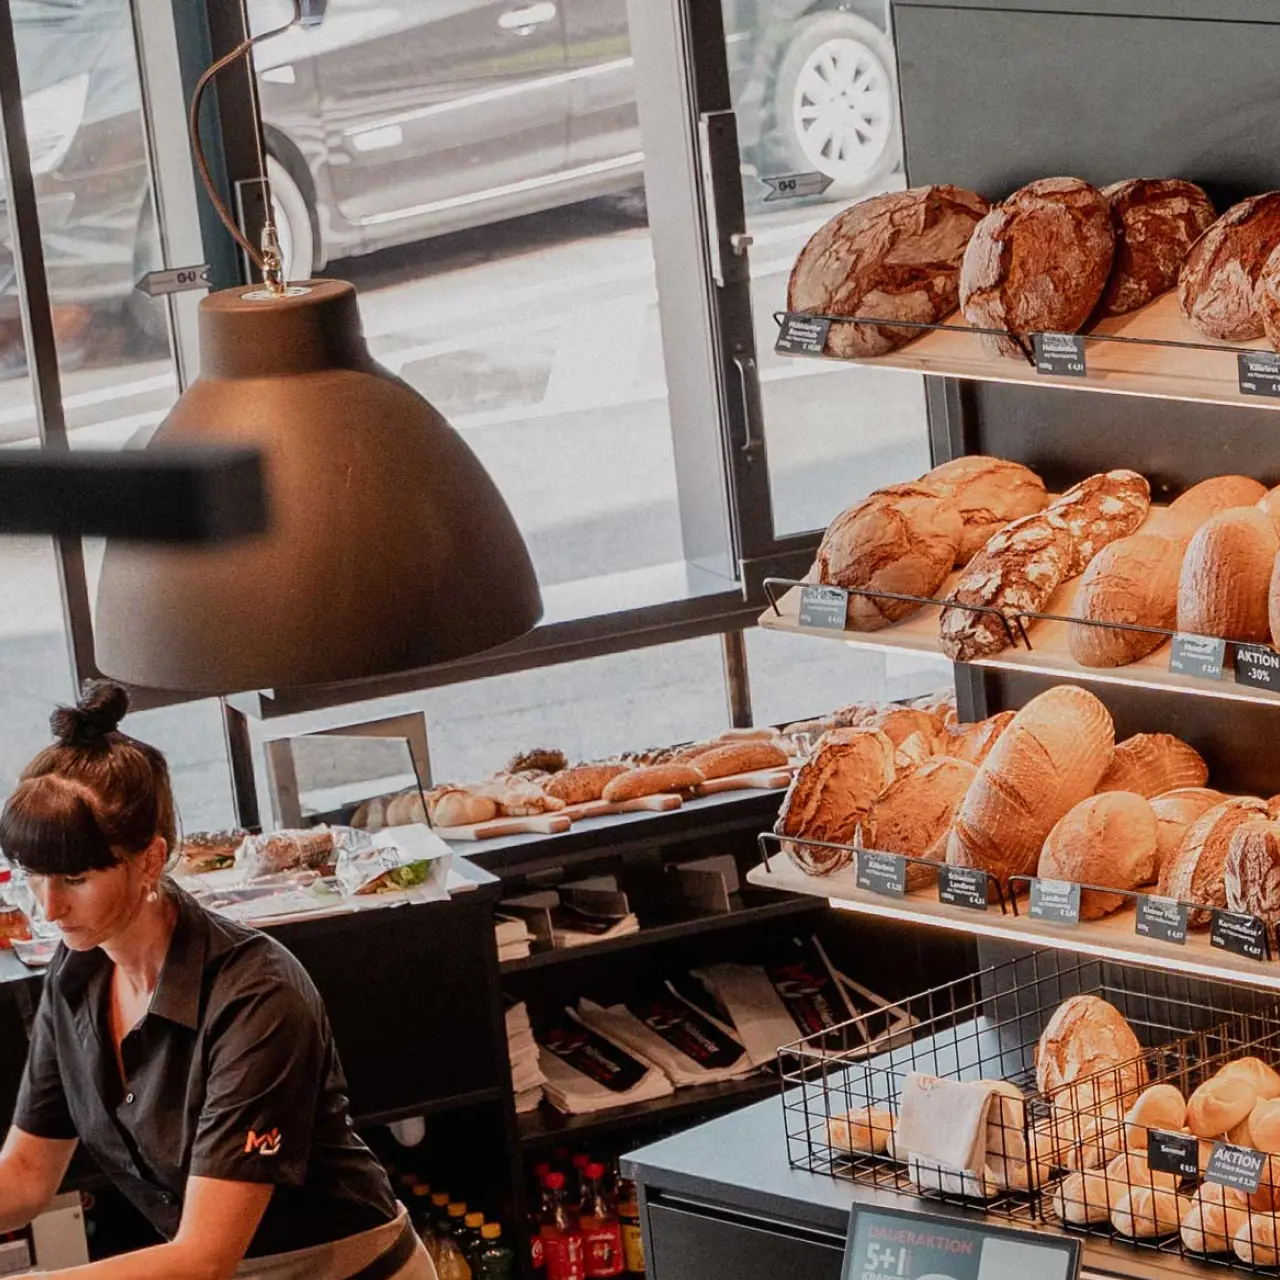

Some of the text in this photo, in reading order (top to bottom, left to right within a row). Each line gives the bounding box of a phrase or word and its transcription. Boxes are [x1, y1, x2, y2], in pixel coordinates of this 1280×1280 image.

[1237, 649, 1280, 668] AKTION
[1248, 667, 1270, 682] -30%
[1214, 1148, 1261, 1170] AKTION
[868, 1225, 972, 1255] DAUERAKTION
